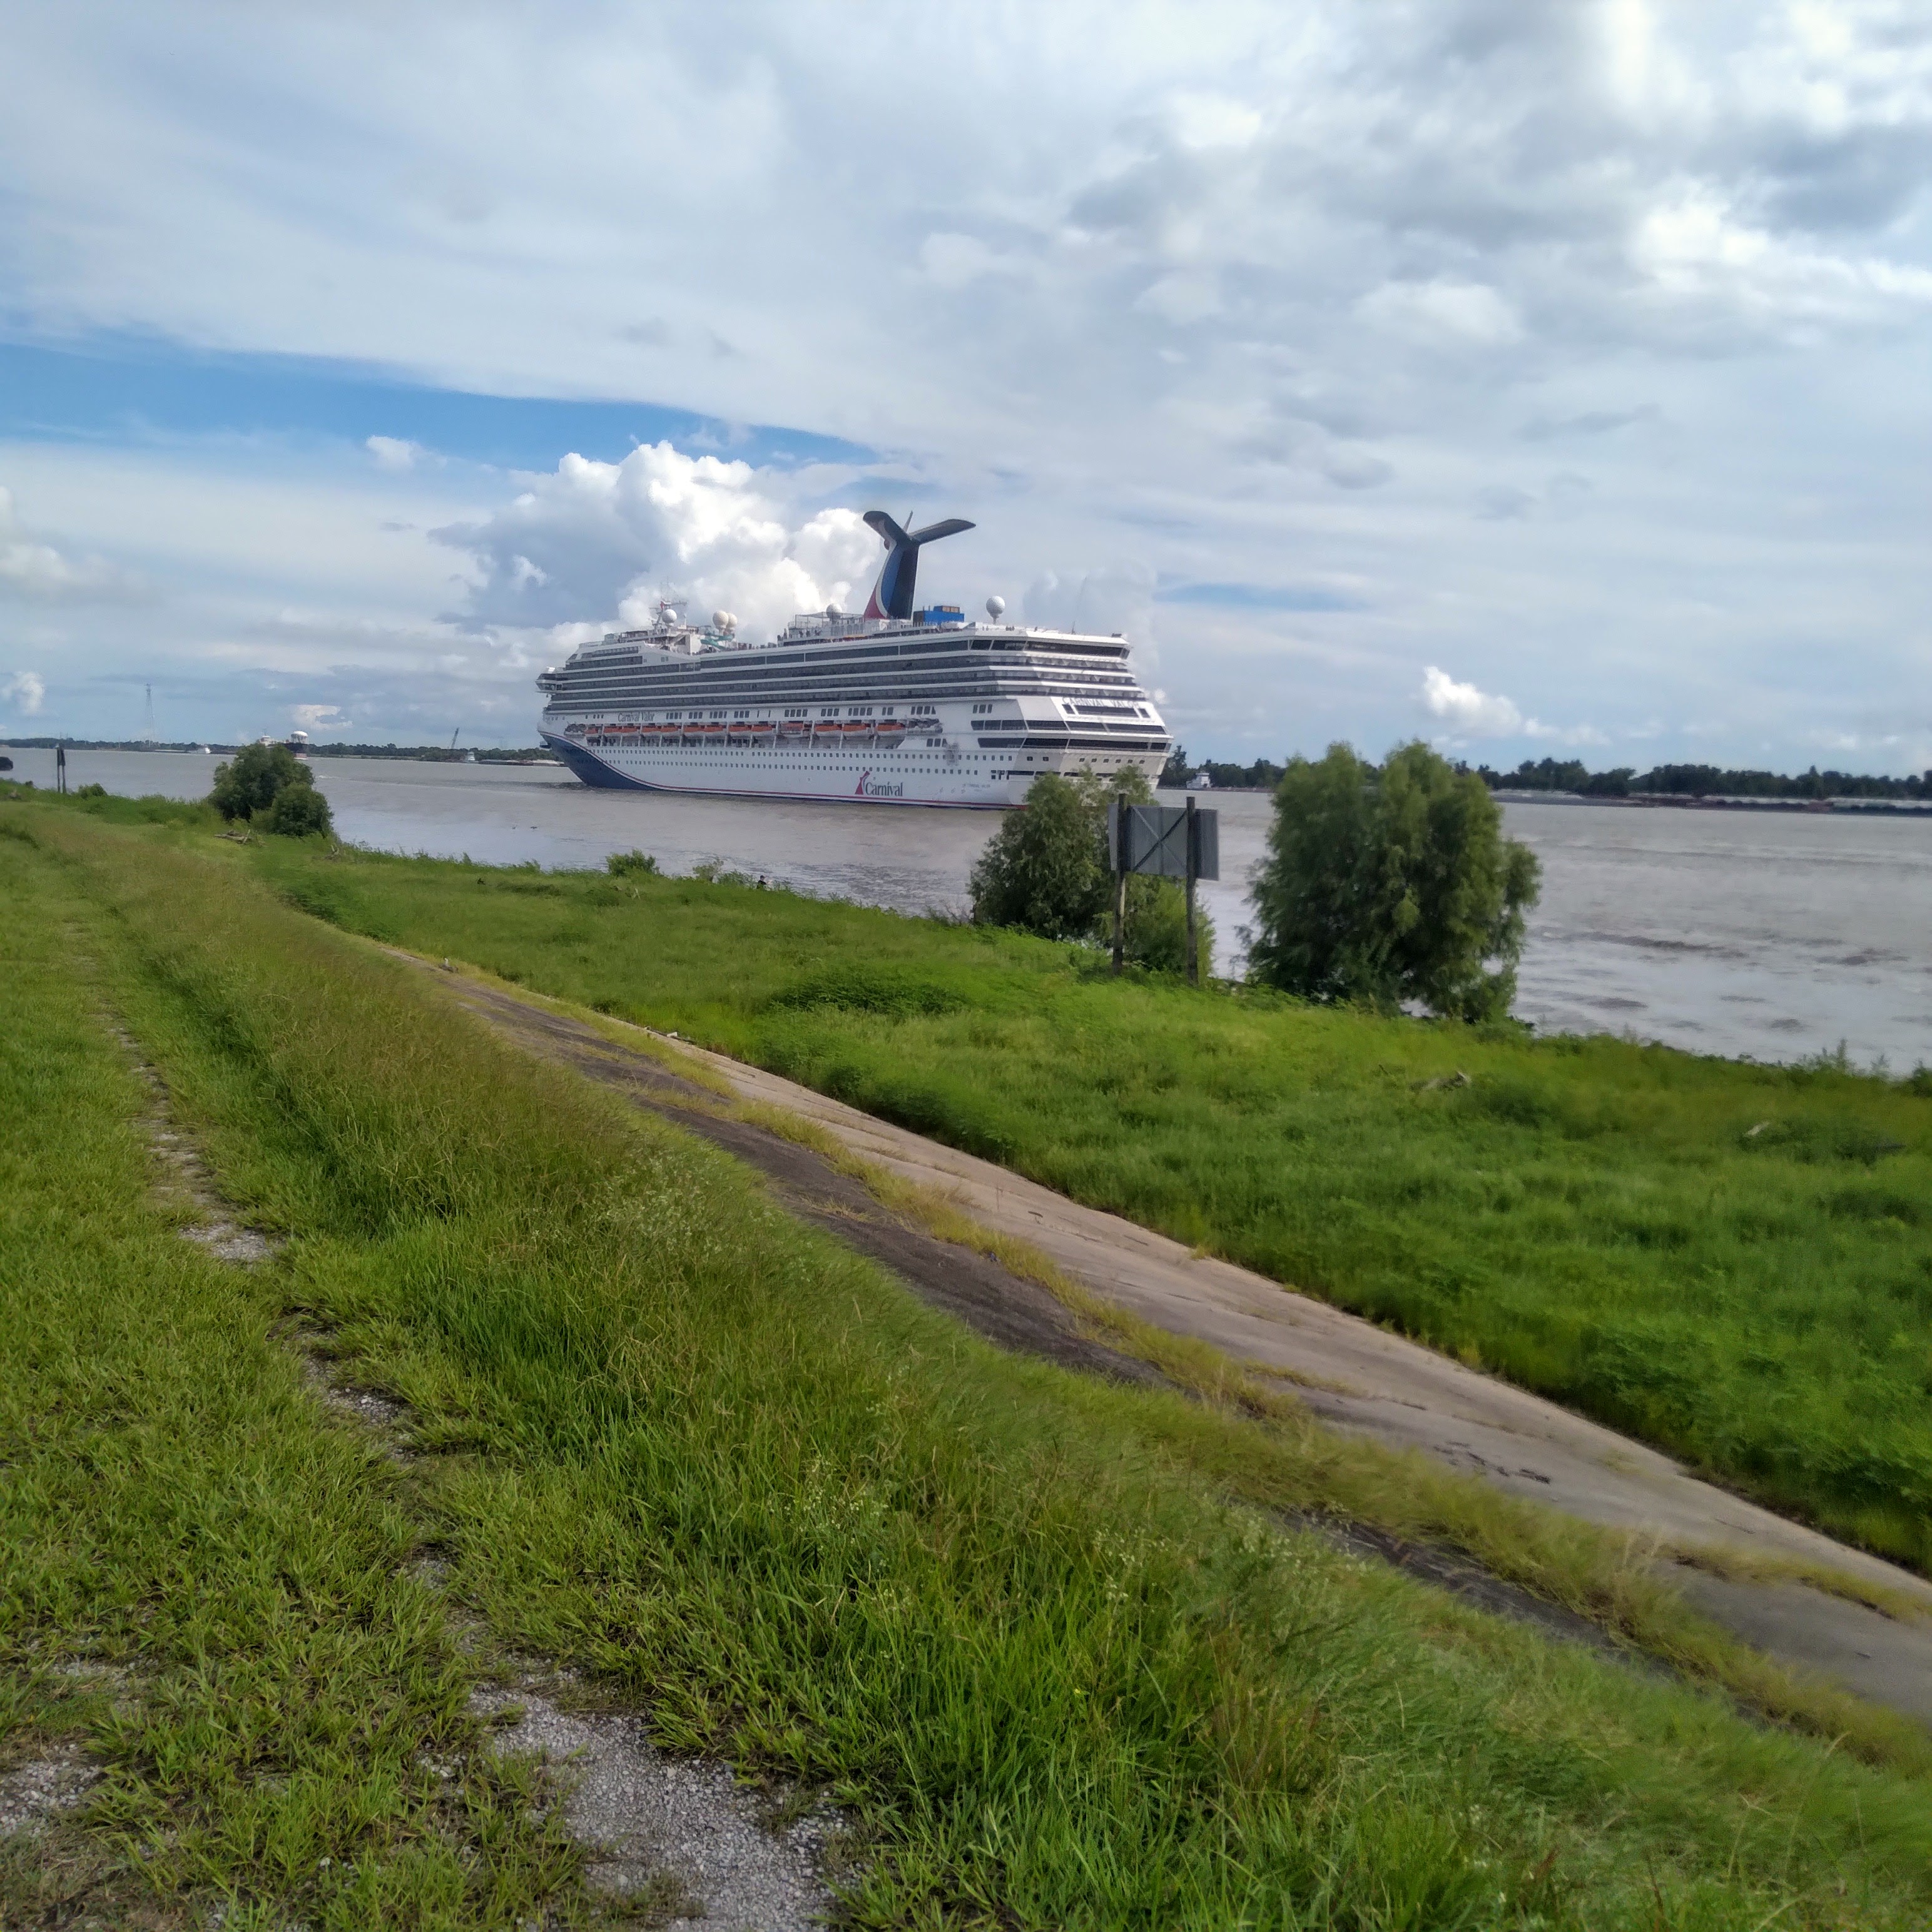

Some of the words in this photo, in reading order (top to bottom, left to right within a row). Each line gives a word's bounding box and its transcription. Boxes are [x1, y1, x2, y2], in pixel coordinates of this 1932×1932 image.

[1062, 697, 1104, 706] CARNIVAL
[618, 711, 640, 722] Carnival
[865, 781, 903, 796] Carnival
